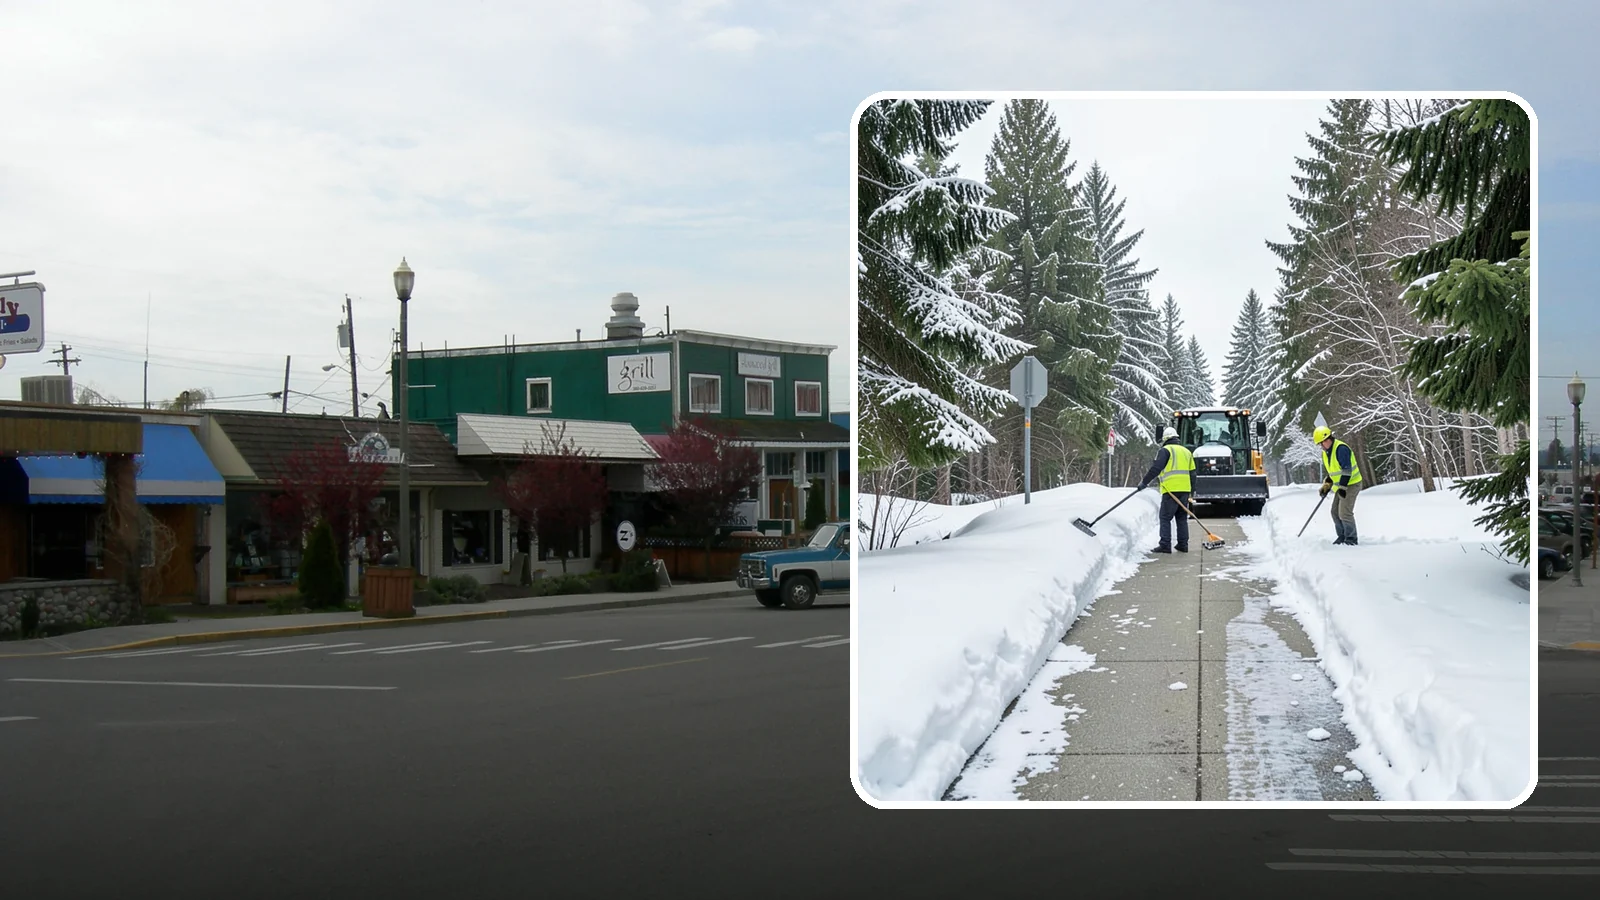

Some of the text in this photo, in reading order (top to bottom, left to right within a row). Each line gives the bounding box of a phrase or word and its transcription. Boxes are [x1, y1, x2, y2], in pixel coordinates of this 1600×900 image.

[3, 336, 38, 346] Fries Salads
[618, 356, 654, 391] grill
